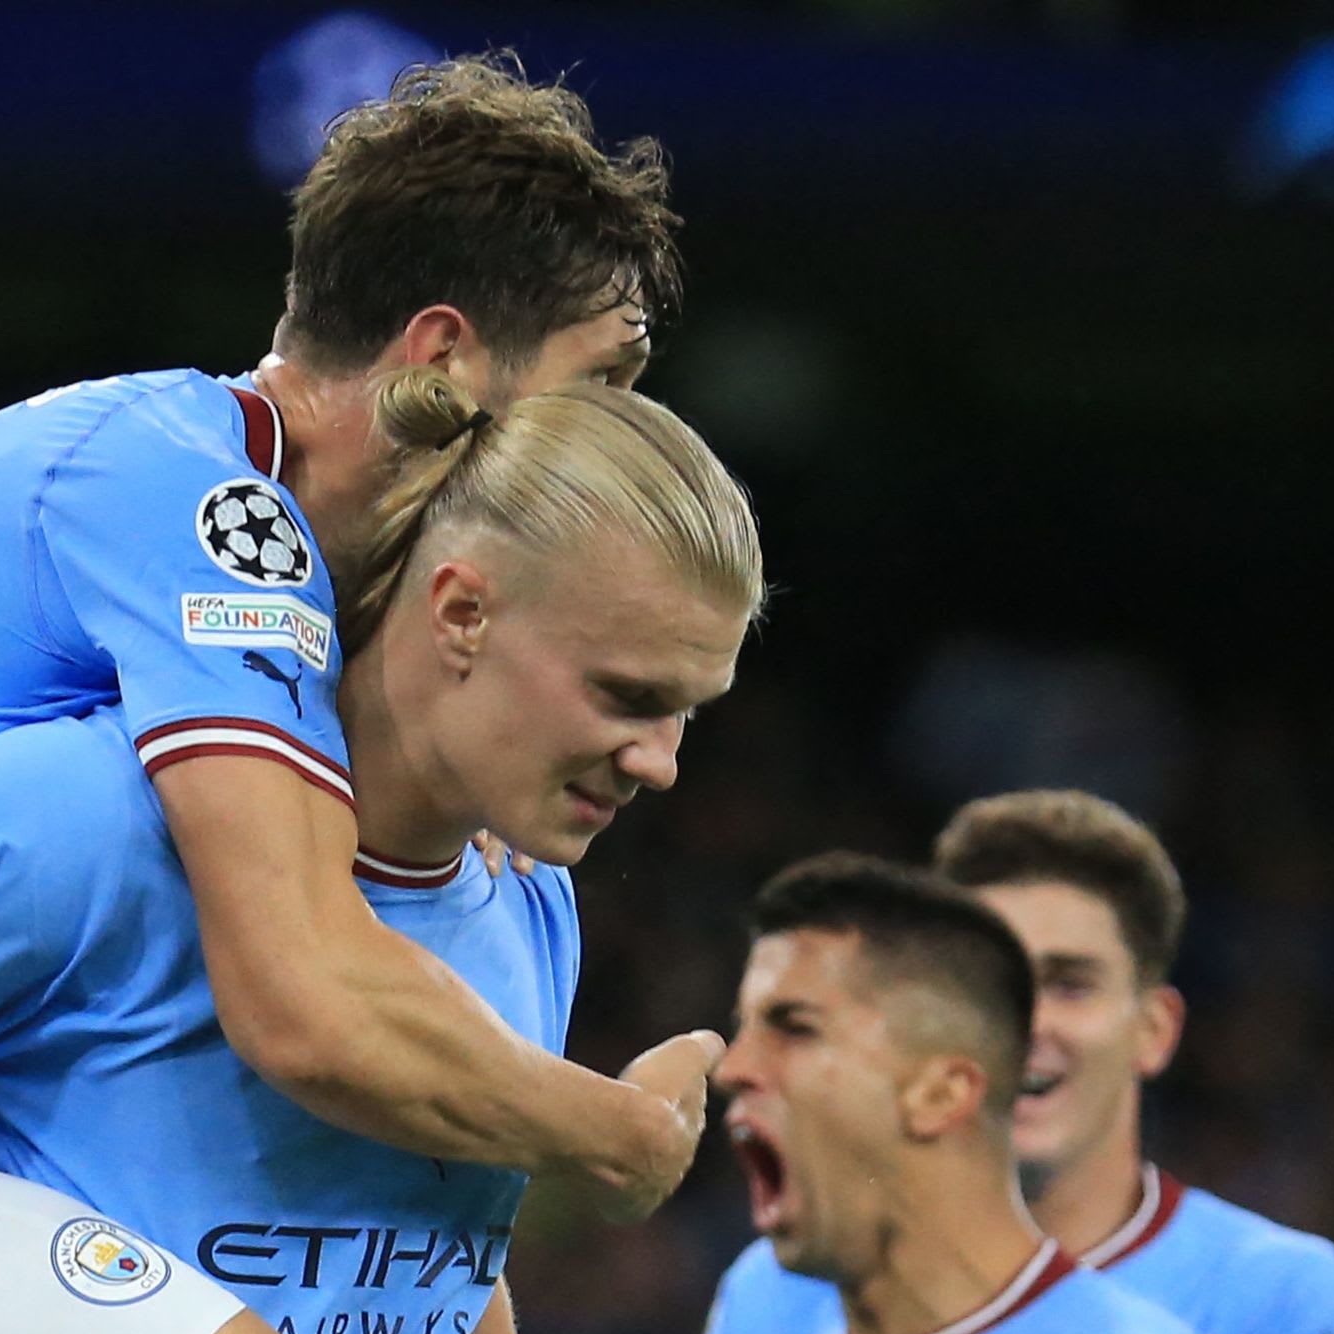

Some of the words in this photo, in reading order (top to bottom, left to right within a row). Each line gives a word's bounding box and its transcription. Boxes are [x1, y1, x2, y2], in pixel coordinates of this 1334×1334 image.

[187, 597, 225, 609] UEFA
[188, 610, 326, 651] FOUNDATION
[140, 1268, 162, 1290] CITY
